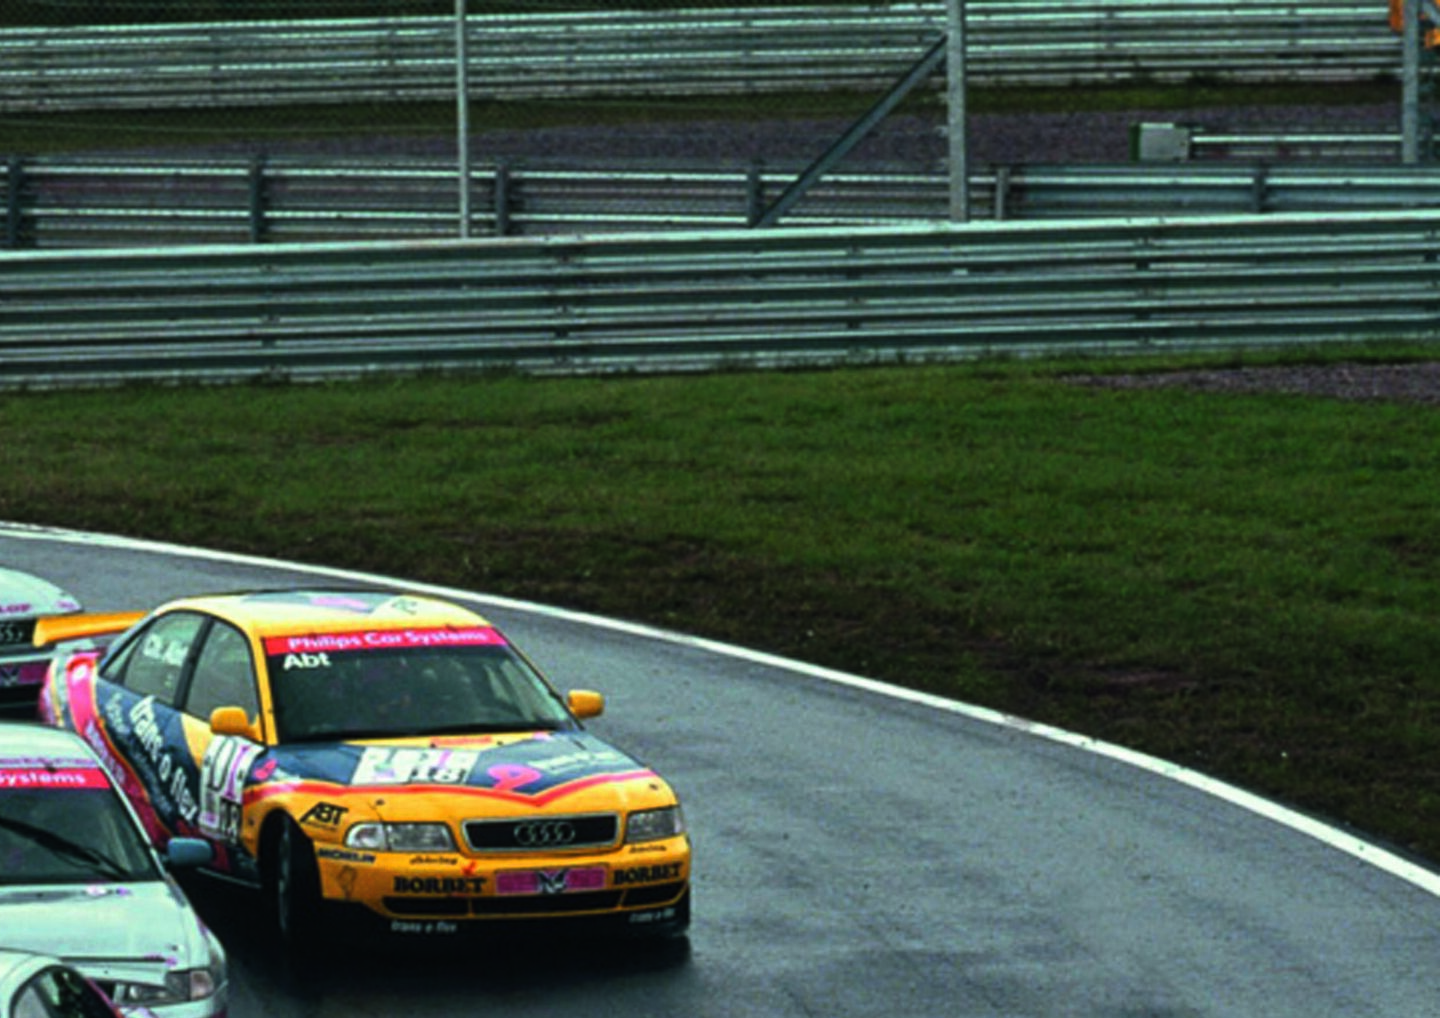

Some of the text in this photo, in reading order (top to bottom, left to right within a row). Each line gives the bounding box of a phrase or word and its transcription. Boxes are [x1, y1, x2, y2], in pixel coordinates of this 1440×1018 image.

[288, 629, 488, 650] Philips Car Systems
[283, 652, 333, 671] Abt
[207, 735, 255, 799] D1
[300, 801, 349, 825] ABT
[319, 848, 376, 865] MICHELIN
[394, 875, 486, 893] BORBET
[613, 863, 683, 885] BORBET
